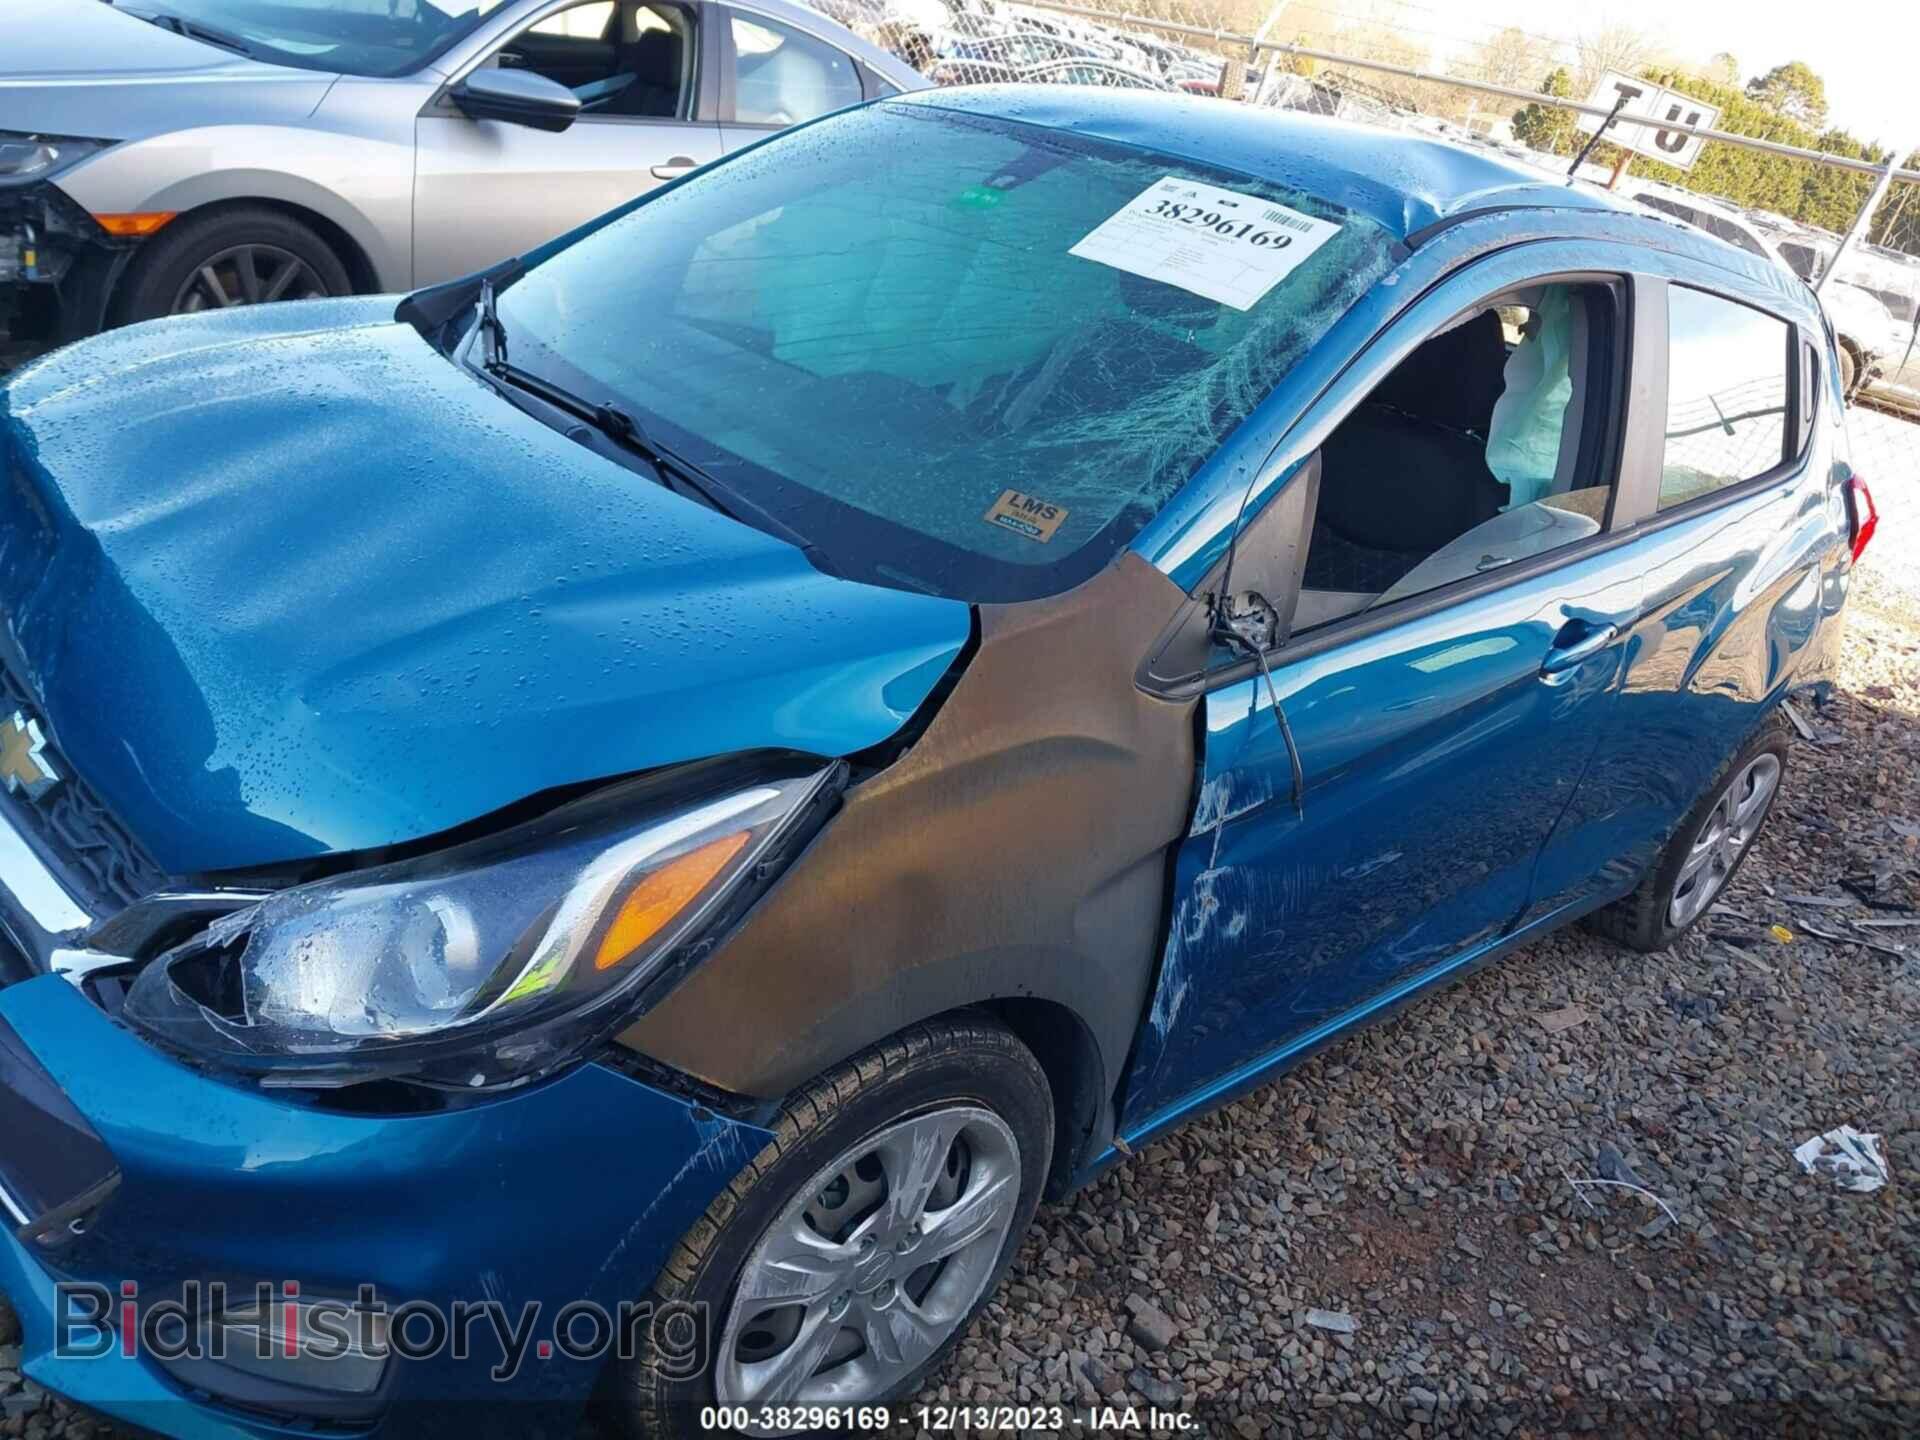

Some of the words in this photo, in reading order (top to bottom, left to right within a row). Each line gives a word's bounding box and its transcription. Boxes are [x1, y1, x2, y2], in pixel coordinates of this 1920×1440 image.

[1609, 83, 1643, 129] T
[1655, 104, 1700, 153] U
[1144, 200, 1292, 249] 38296169
[1008, 494, 1058, 519] LMS
